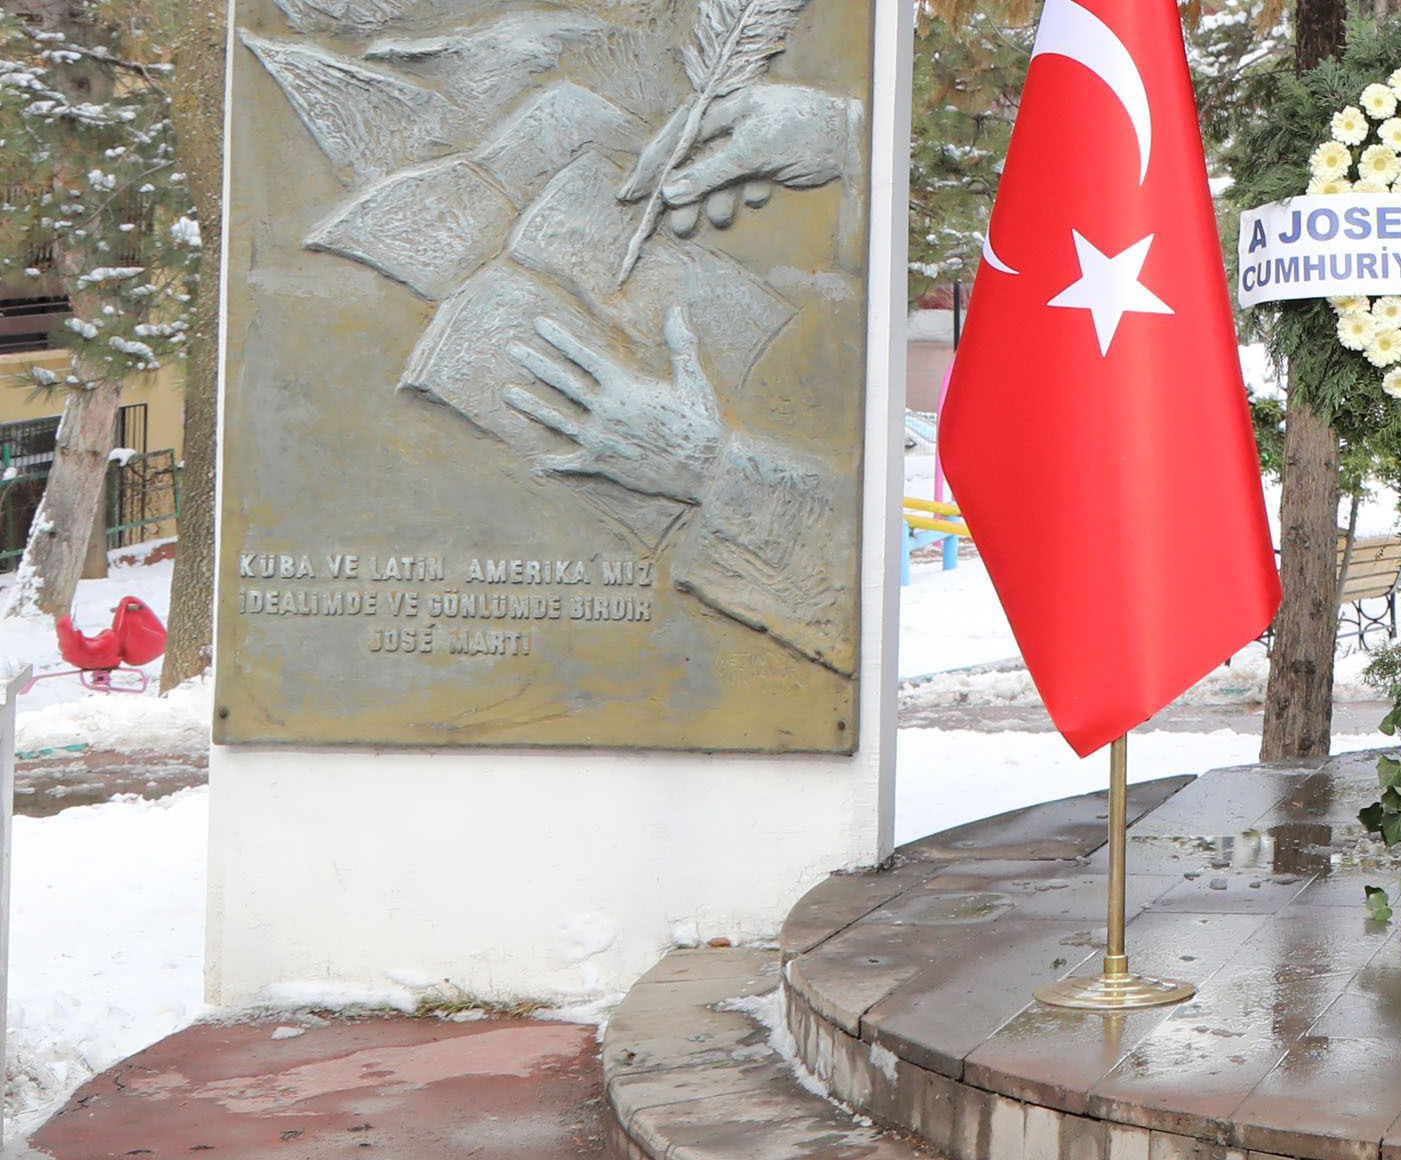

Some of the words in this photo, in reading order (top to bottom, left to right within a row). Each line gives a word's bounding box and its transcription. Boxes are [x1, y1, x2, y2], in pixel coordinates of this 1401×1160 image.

[1248, 218, 1266, 253] A
[1278, 205, 1401, 242] JOSE
[239, 553, 316, 579] KÜBA
[325, 555, 359, 578] VE
[387, 592, 418, 617] VE
[428, 589, 561, 620] GÖNLÜMDE
